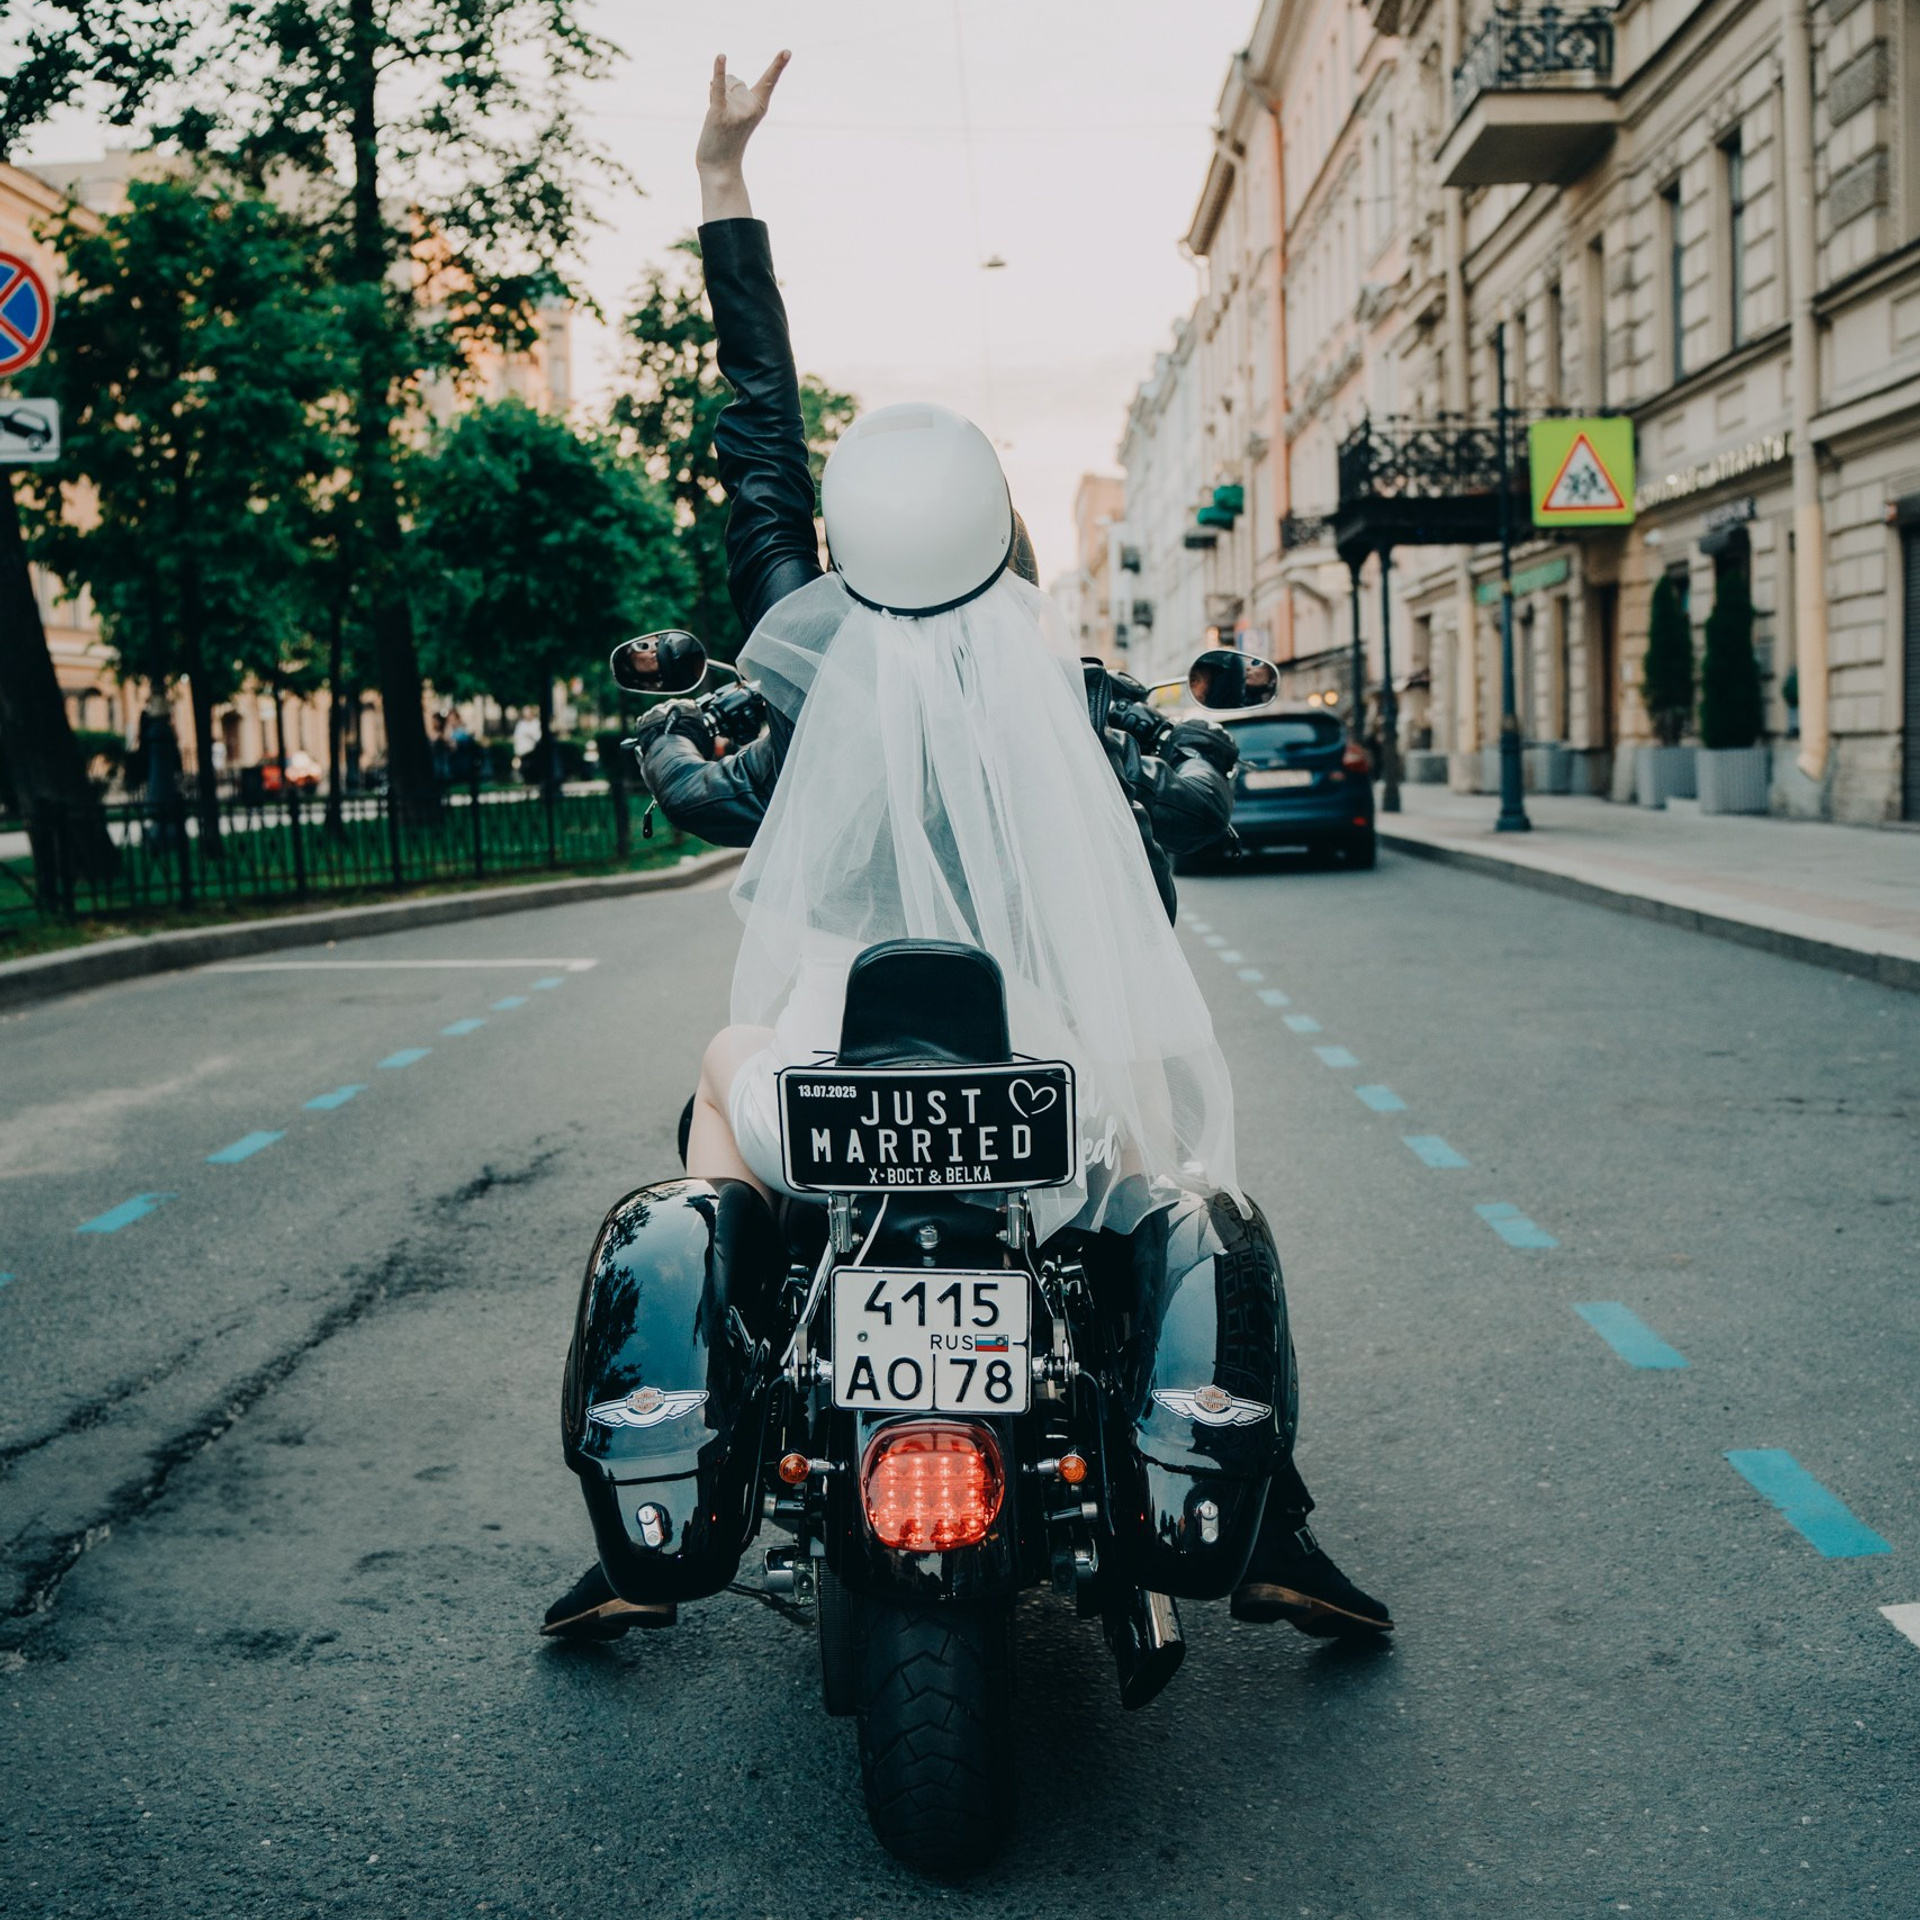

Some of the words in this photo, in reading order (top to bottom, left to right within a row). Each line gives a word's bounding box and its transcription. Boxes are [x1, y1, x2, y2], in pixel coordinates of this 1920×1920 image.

[860, 1088, 981, 1126] JUST
[810, 1124, 1032, 1163] MARRIED
[928, 1169, 942, 1184] &
[945, 1165, 992, 1183] BELKA
[864, 1280, 1000, 1328] 4115
[930, 1334, 974, 1350] RUS
[845, 1355, 923, 1401] AO
[949, 1358, 1014, 1404] 78
